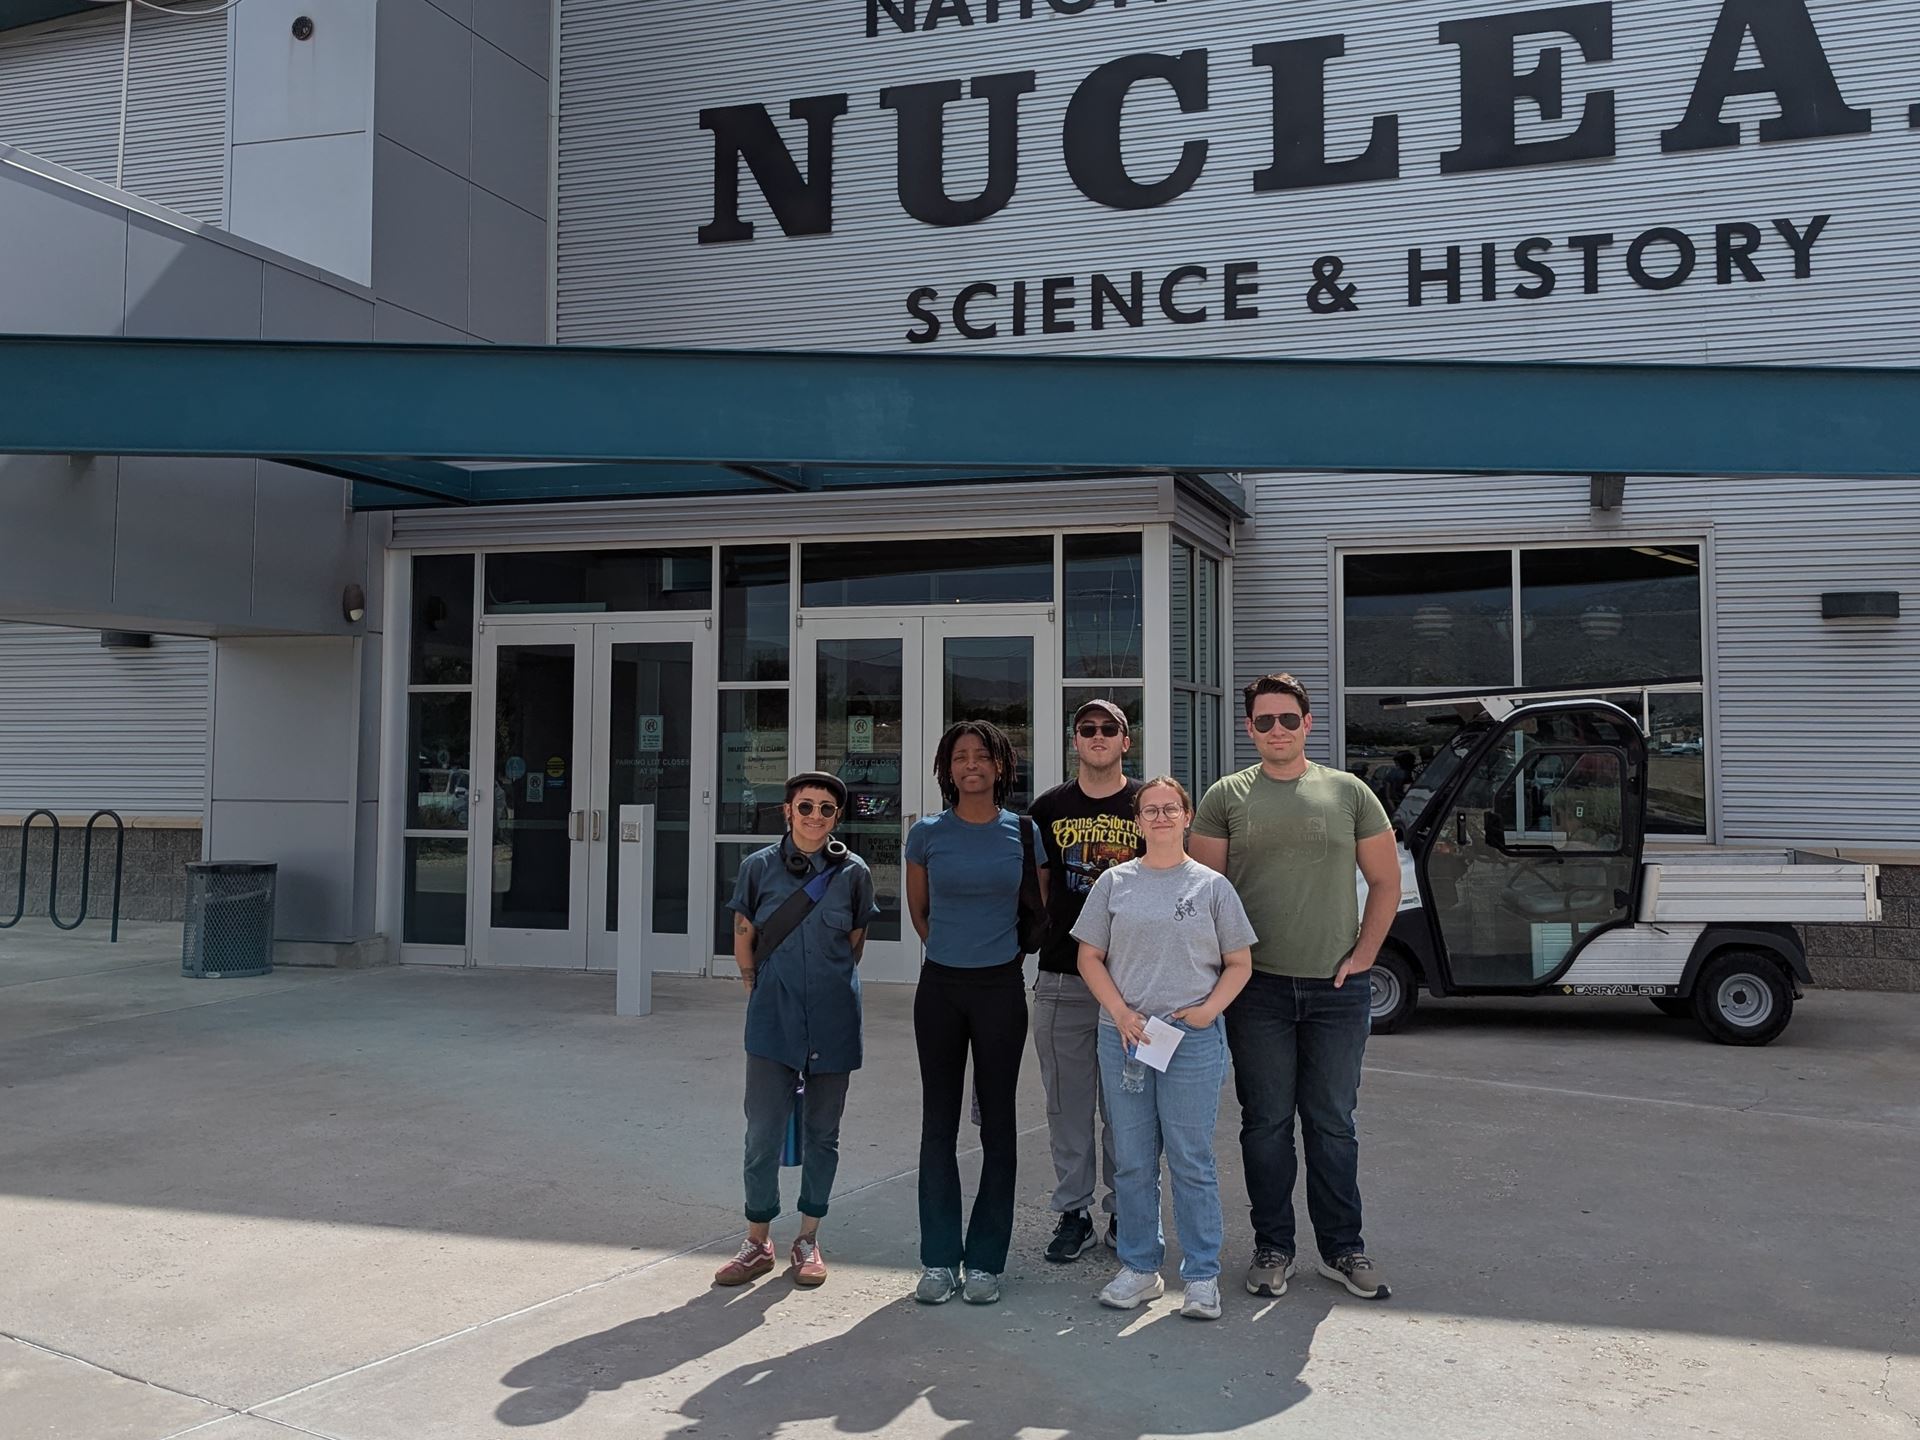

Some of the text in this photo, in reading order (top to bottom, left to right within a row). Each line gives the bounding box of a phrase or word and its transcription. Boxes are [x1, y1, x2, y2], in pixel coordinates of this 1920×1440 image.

[697, 0, 1920, 245] NUCLEA
[905, 214, 1829, 344] SCIENCE & HISTORY
[1056, 825, 1138, 849] Orchestra
[1574, 984, 1666, 996] CARRYALL 510
